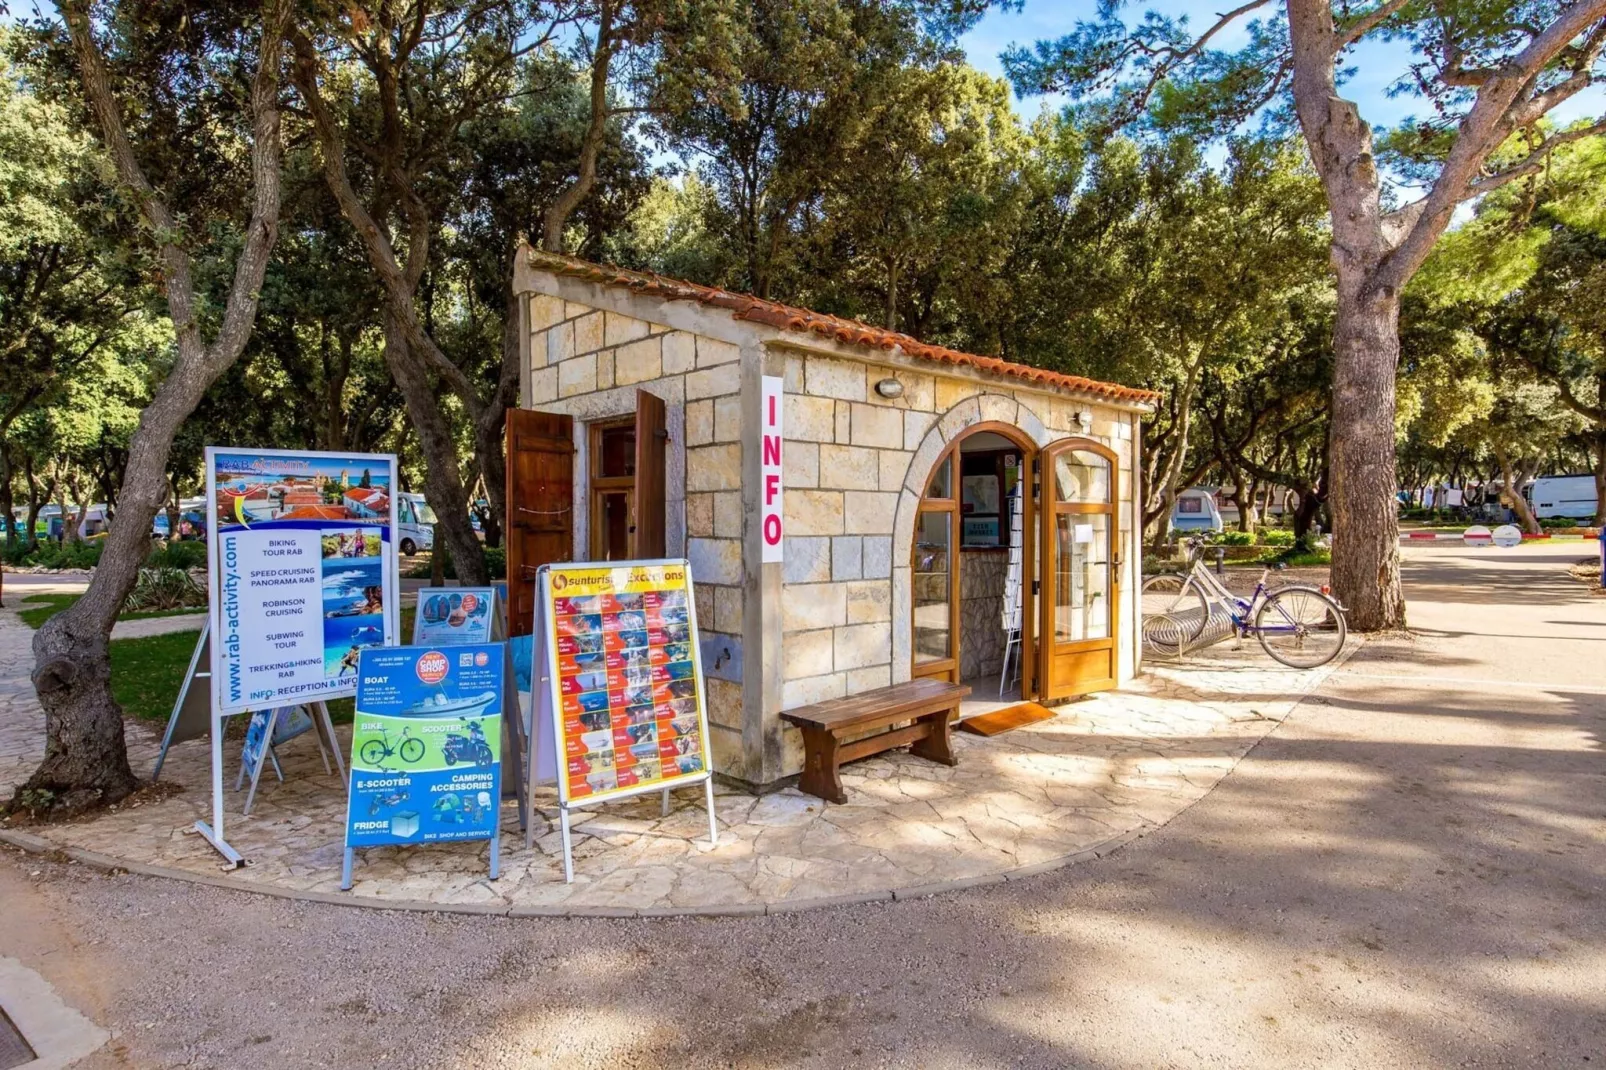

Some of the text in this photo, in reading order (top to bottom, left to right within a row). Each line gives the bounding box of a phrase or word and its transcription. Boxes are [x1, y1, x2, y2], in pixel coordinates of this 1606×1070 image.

[222, 460, 249, 469] RAB
[764, 395, 782, 546] INFO
[269, 539, 296, 547] BIKING
[287, 548, 303, 556] RAB
[250, 567, 315, 578] SPEED CRUISING
[251, 576, 315, 587] PANORAMA RAB
[262, 598, 306, 608] ROBINSON
[265, 607, 303, 617] CRUISING
[223, 536, 242, 703] www.rab-activity.com
[265, 630, 304, 641] SUBWING
[274, 641, 297, 649] TOUR
[248, 657, 323, 673] TREKKING&HIKING
[419, 659, 446, 668] CAMP
[420, 665, 445, 673] SHOP
[278, 670, 295, 679] RAB
[364, 676, 389, 685] BOAT
[249, 689, 276, 700] INFO:
[277, 681, 328, 695] RECEPTION
[330, 680, 337, 688] &
[361, 722, 462, 733] BIKE SCOOTER
[357, 778, 411, 788] E-SCOOTER
[451, 773, 493, 783] CAMPING
[430, 781, 493, 793] ACCESSORIES
[353, 820, 389, 830] FRIDGE
